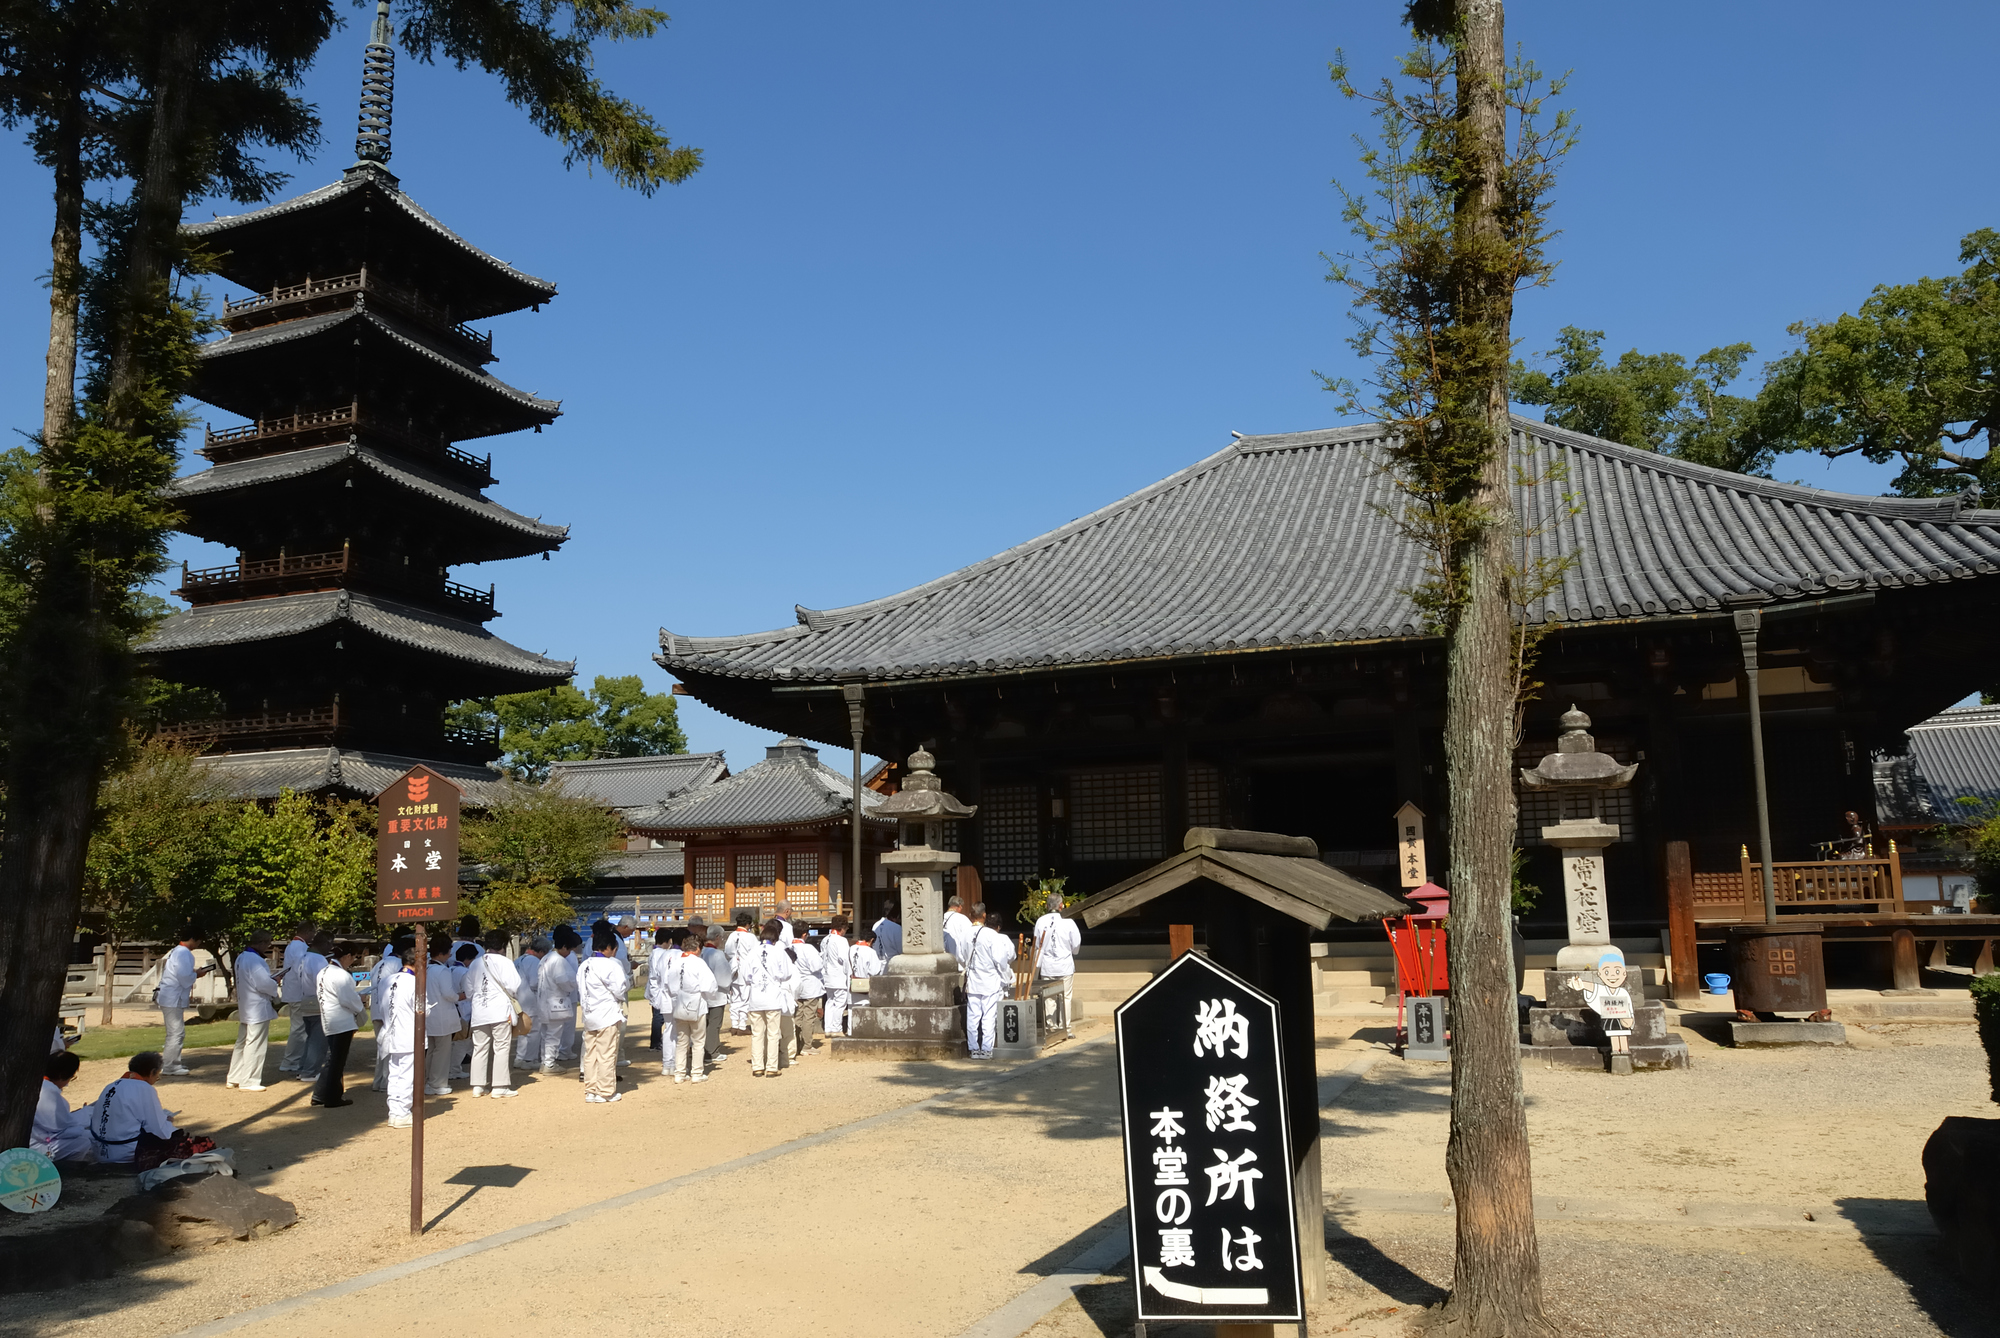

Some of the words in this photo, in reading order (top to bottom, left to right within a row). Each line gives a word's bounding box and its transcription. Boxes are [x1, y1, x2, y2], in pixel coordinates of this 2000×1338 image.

[398, 803, 439, 816] 文化財愛護
[387, 816, 448, 834] 重要文化財
[390, 850, 442, 873] 本堂
[391, 886, 442, 901] 火気厳禁
[398, 907, 434, 918] HITACHI
[1006, 1006, 1017, 1041] 本山寺
[1418, 1004, 1431, 1042] 本山寺
[1193, 998, 1264, 1272] 納経所は
[1150, 1106, 1196, 1268] 本堂の裏
